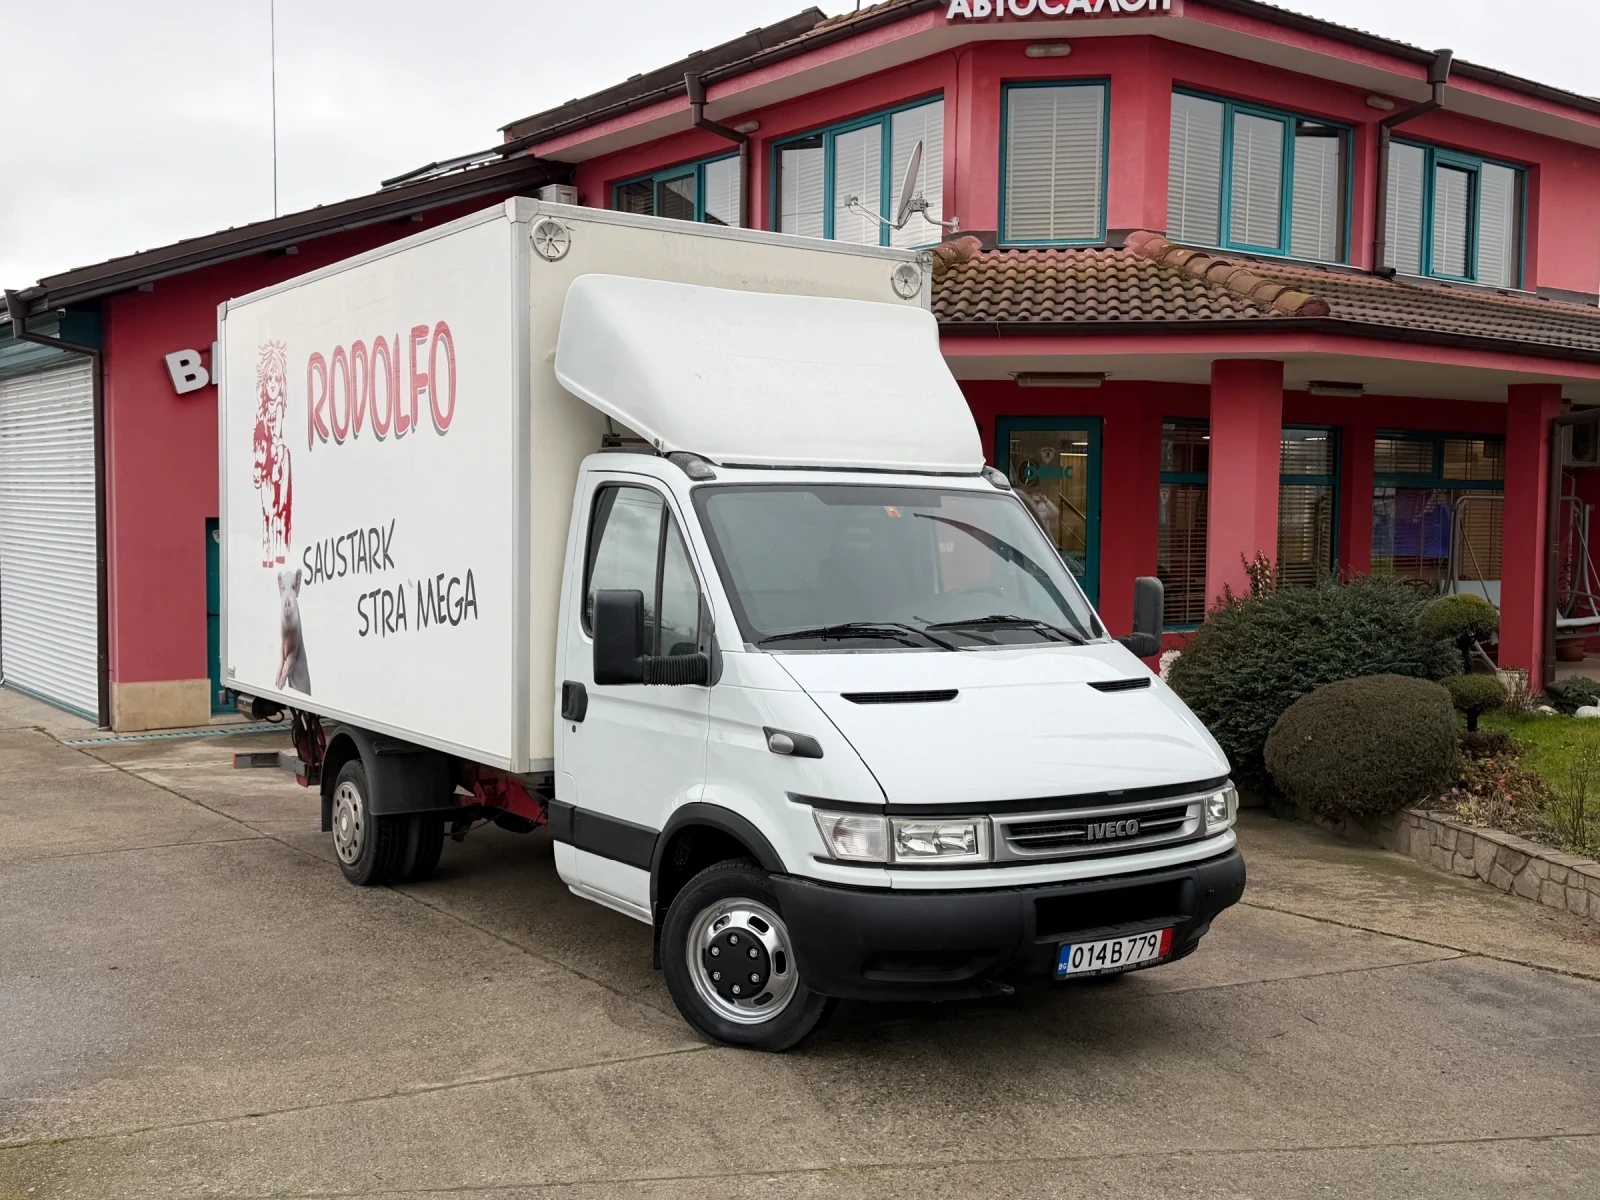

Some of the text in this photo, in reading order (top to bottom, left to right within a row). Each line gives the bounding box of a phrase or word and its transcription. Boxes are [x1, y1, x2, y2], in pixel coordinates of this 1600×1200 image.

[307, 320, 456, 452] RODOLFO
[303, 518, 395, 585] SAUSTARK
[357, 568, 478, 638] STRA MEGA
[1087, 819, 1139, 840] IVECO
[1058, 962, 1068, 971] BG
[1072, 934, 1157, 968] 014B779
